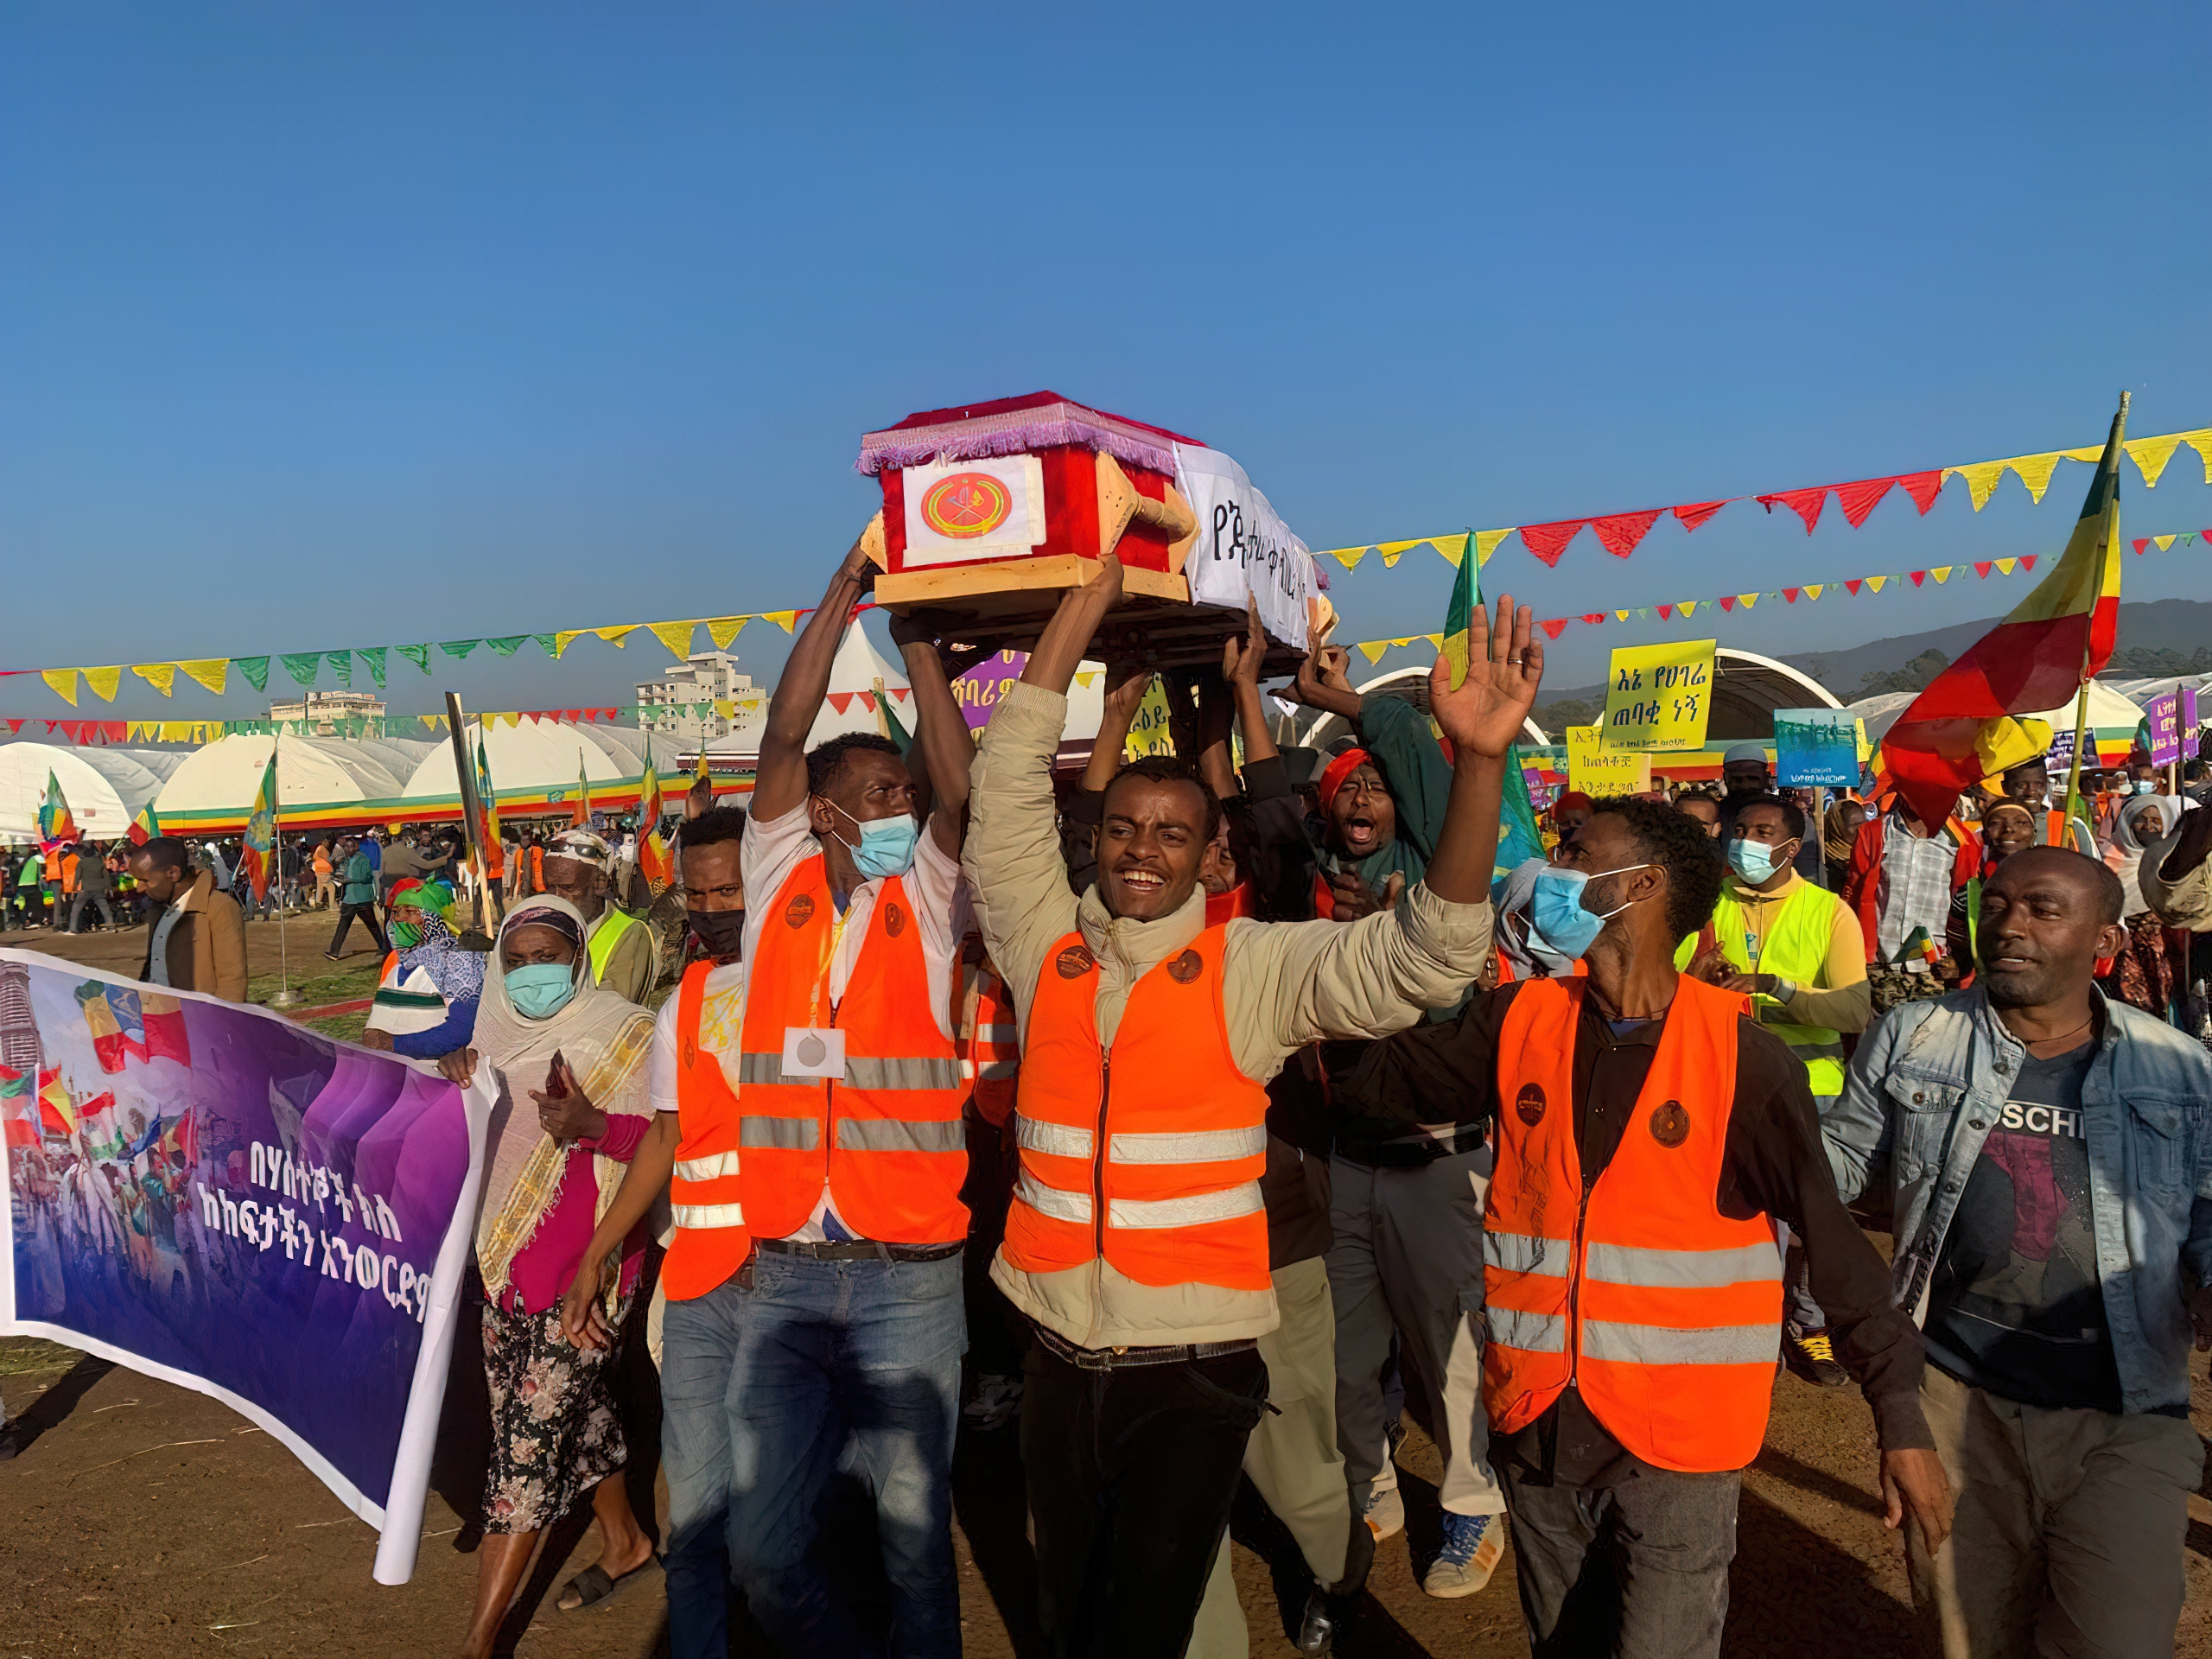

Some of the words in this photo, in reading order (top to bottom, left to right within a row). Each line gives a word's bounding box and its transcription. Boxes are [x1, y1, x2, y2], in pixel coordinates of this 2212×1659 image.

[1617, 668, 1643, 691] እኔ
[1654, 663, 1707, 689] የሀገሬ
[1612, 699, 1661, 727] ጠባቂ
[1673, 693, 1700, 722] ነኝ
